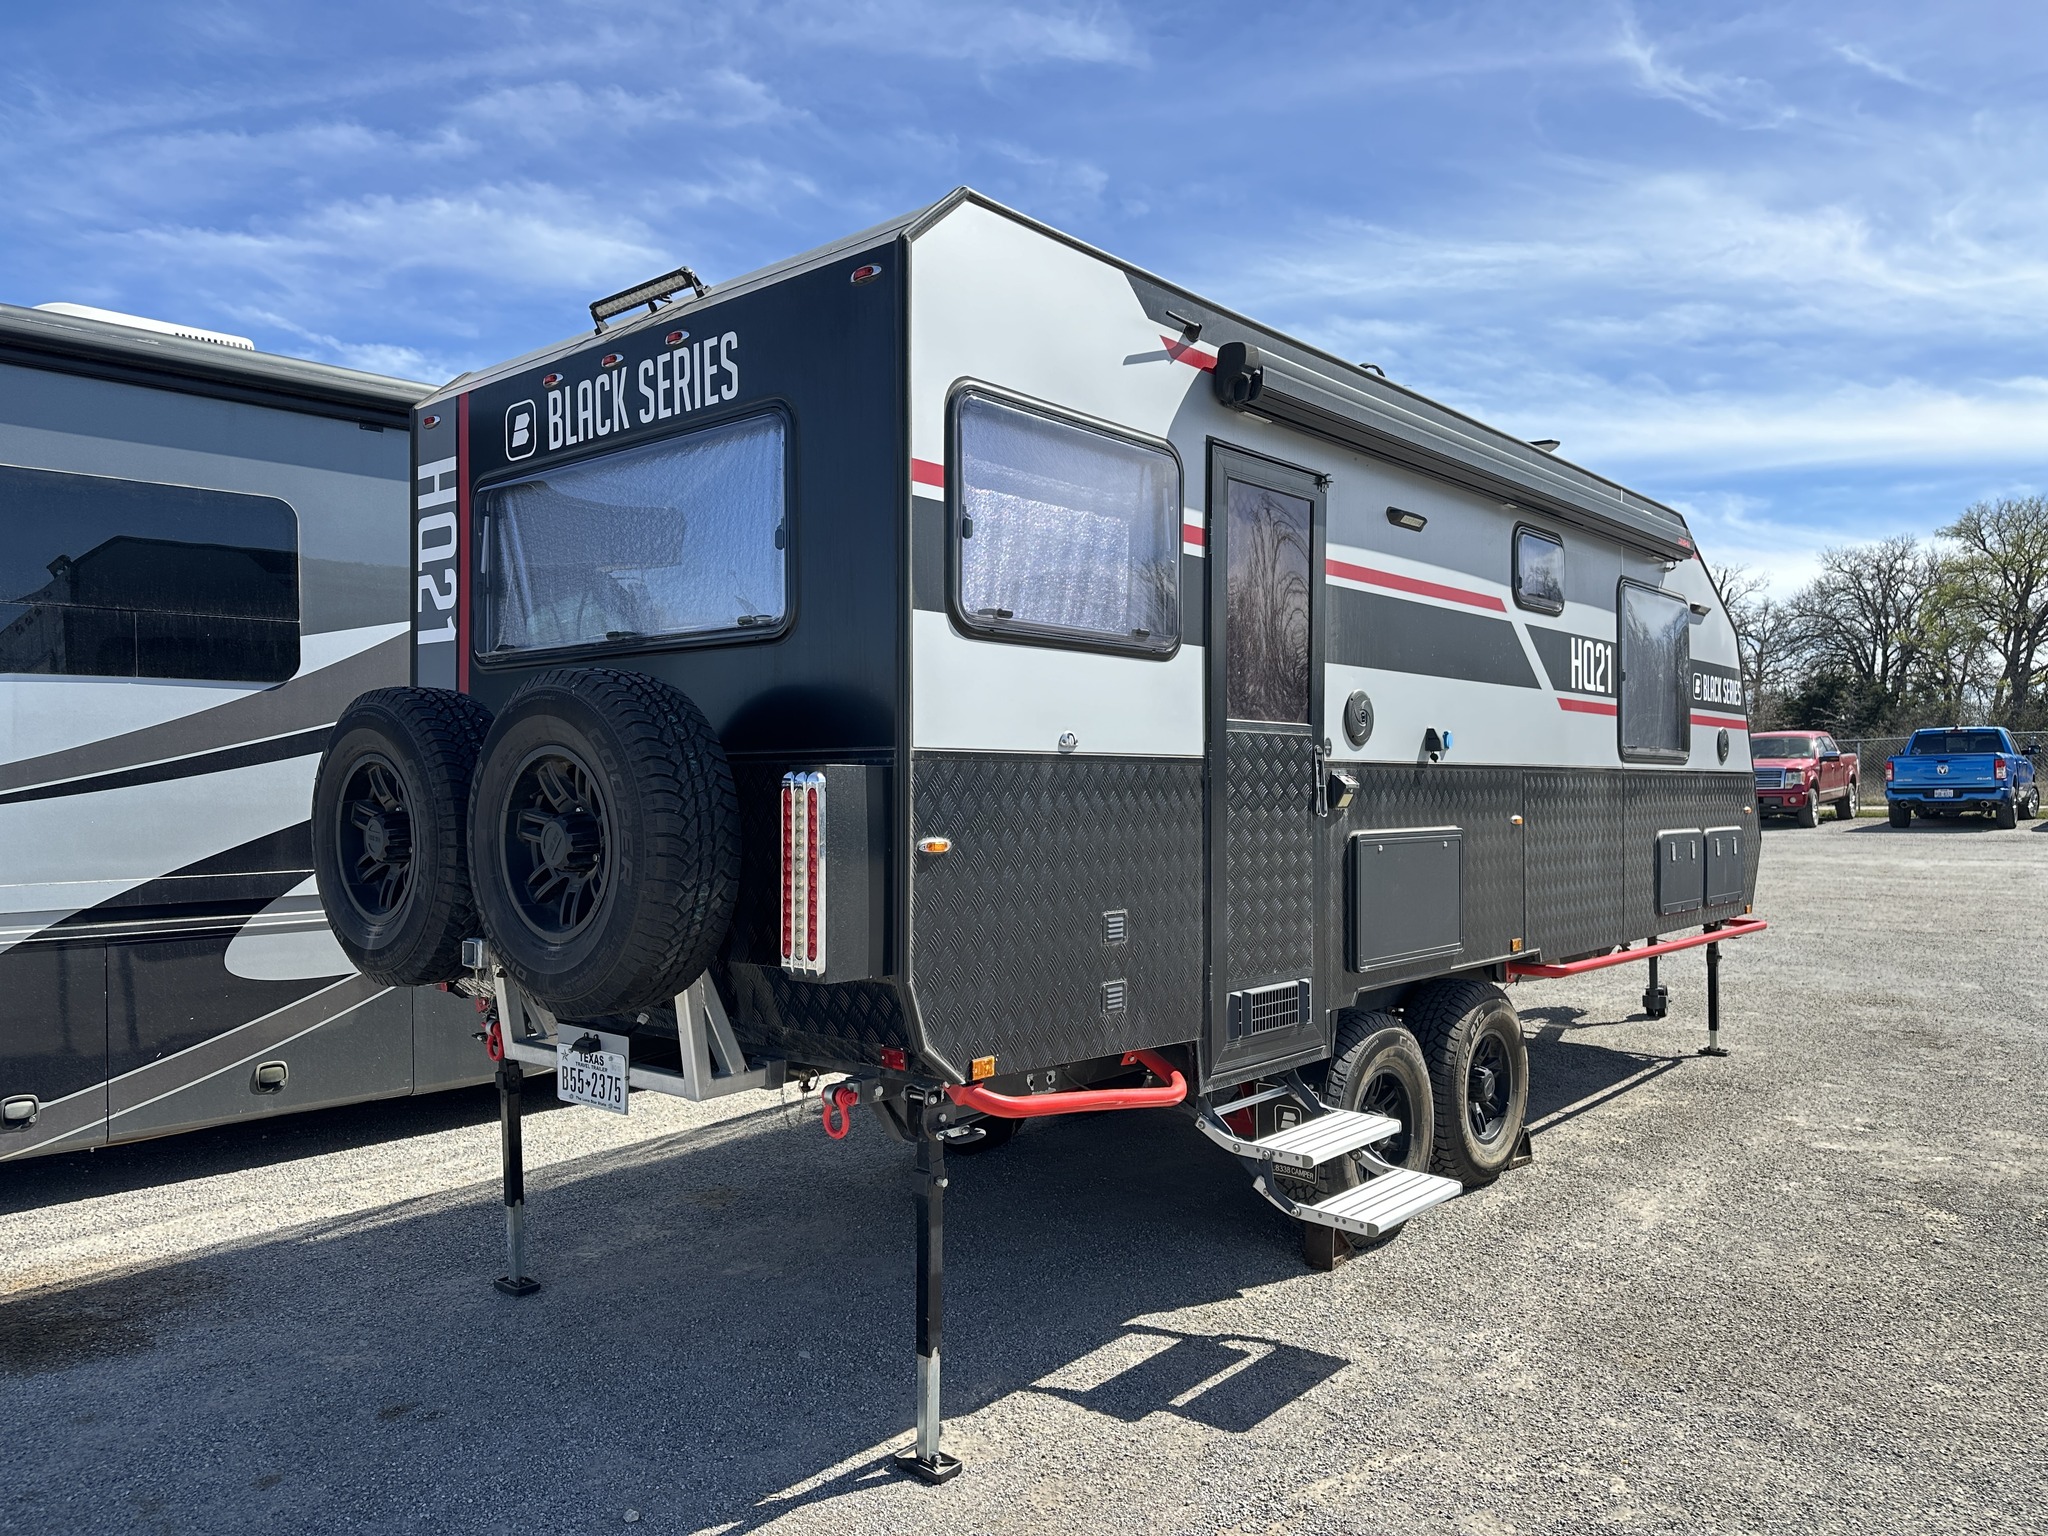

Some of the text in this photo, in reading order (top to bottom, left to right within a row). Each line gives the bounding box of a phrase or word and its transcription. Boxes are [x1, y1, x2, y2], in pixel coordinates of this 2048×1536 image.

[548, 366, 630, 451] BLACK
[638, 330, 739, 424] SERIES
[417, 456, 457, 645] HQ21
[1570, 637, 1612, 693] HQ21
[1702, 674, 1722, 704] BLACK
[1722, 678, 1741, 706] SERIES
[588, 727, 633, 887] COOPER
[580, 1052, 604, 1066] TEXAS
[562, 1066, 621, 1103] B55 2375
[1291, 1167, 1314, 1181] CAMPER
